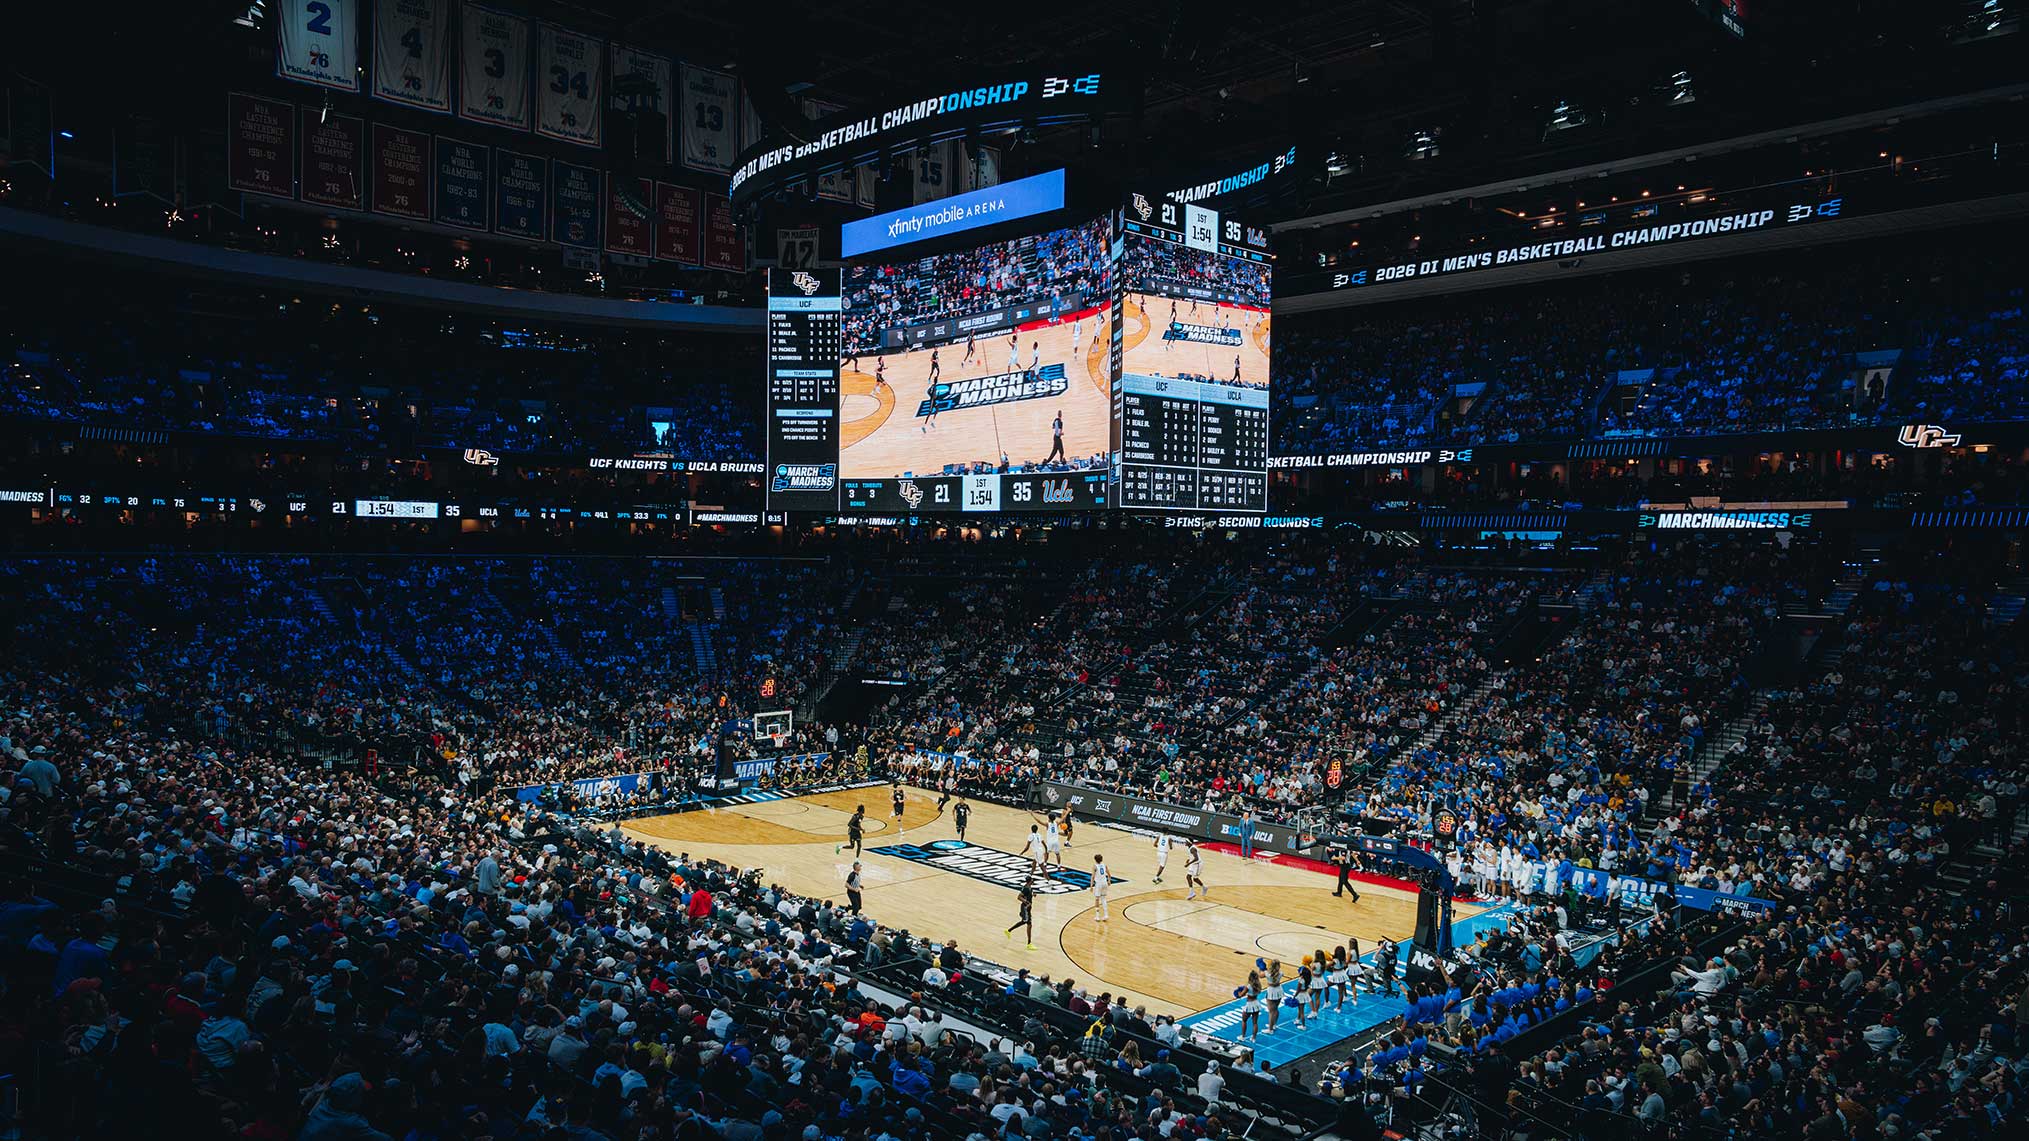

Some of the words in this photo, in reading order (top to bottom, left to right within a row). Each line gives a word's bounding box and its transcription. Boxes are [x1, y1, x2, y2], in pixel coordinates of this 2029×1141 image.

[307, 3, 331, 36] 2
[401, 28, 422, 59] 4
[310, 50, 328, 67] 76
[484, 48, 505, 79] 3
[286, 64, 332, 80] Philadelphia
[404, 76, 421, 91] 76
[551, 64, 589, 99] 34
[487, 95, 503, 110] 76
[560, 112, 576, 127] 76
[695, 102, 723, 132] 13
[731, 170, 747, 190] 2026
[758, 146, 793, 172] MEN'S
[881, 81, 1029, 130] CHAMPIONSHIP
[325, 182, 341, 194] 76
[394, 193, 409, 206] 76
[1132, 193, 1153, 221] UCF
[888, 210, 923, 238] xfinity
[924, 205, 964, 229] mobile
[966, 199, 1005, 218] ARENA
[1161, 203, 1177, 225] 21
[1197, 213, 1207, 223] 1ST
[1160, 230, 1165, 239] 3
[1178, 235, 1183, 243] 3
[1192, 225, 1212, 243] 1:54
[1225, 220, 1241, 242] 35
[1227, 247, 1232, 255] 4
[1242, 251, 1247, 259] 4
[1375, 263, 1416, 283] 2026
[1419, 260, 1440, 276] DI
[1442, 252, 1492, 273] MEN'S
[1495, 236, 1607, 264] BASKETBALL
[1611, 209, 1775, 249] CHAMPIONSHIP
[792, 272, 821, 296] UCF
[1182, 324, 1222, 335] MARCH
[1188, 331, 1243, 345] MADNESS
[950, 373, 1024, 394] MARCH
[958, 377, 1068, 405] MADNESS
[1155, 382, 1168, 392] UCF
[1228, 391, 1242, 401] UCLA
[589, 458, 613, 469] UCF
[614, 459, 668, 470] KNIGHTS
[671, 462, 684, 471] VS
[687, 461, 718, 472] UCLA
[719, 462, 765, 473] BRUINS
[1327, 450, 1431, 467] CHAMPIONSHIP
[787, 467, 819, 477] MARCH
[790, 476, 833, 486] MADNESS
[975, 479, 987, 487] 1ST
[848, 489, 855, 498] 3
[869, 489, 875, 497] 3
[898, 480, 924, 509] UCF
[935, 484, 950, 503] 21
[970, 490, 993, 505] 1:54
[1012, 482, 1032, 502] 35
[58, 494, 72, 502] FG%
[79, 495, 91, 504] 32
[103, 496, 121, 504] 3PT%
[127, 497, 139, 506] 20
[152, 498, 166, 506] FT%
[174, 498, 185, 507] 75
[219, 503, 224, 511] 3
[290, 502, 307, 512] UCF
[332, 502, 347, 514] 21
[368, 502, 394, 515] 1:54
[412, 505, 424, 514] 1ST
[445, 505, 460, 517] 35
[479, 507, 498, 517] UCLA
[540, 512, 546, 520] 4
[633, 512, 649, 520] 33.3
[675, 512, 681, 521] 0
[696, 512, 758, 523] #MARCHMADNESS
[768, 514, 782, 522] 8:15
[1218, 516, 1262, 528] SECOND
[1263, 516, 1311, 528] ROUNDS
[1657, 512, 1791, 529] MARCHMADNESS
[761, 685, 774, 696] 28
[1327, 770, 1340, 786] 28
[1070, 794, 1084, 805] UCF
[1131, 804, 1151, 816] NCAA
[1152, 808, 1172, 820] FIRST
[1173, 812, 1201, 826] ROUND
[1439, 823, 1452, 833] 28
[1161, 839, 1166, 847] 2
[1254, 831, 1274, 843] UCLA
[1721, 898, 1750, 910] MARCH
